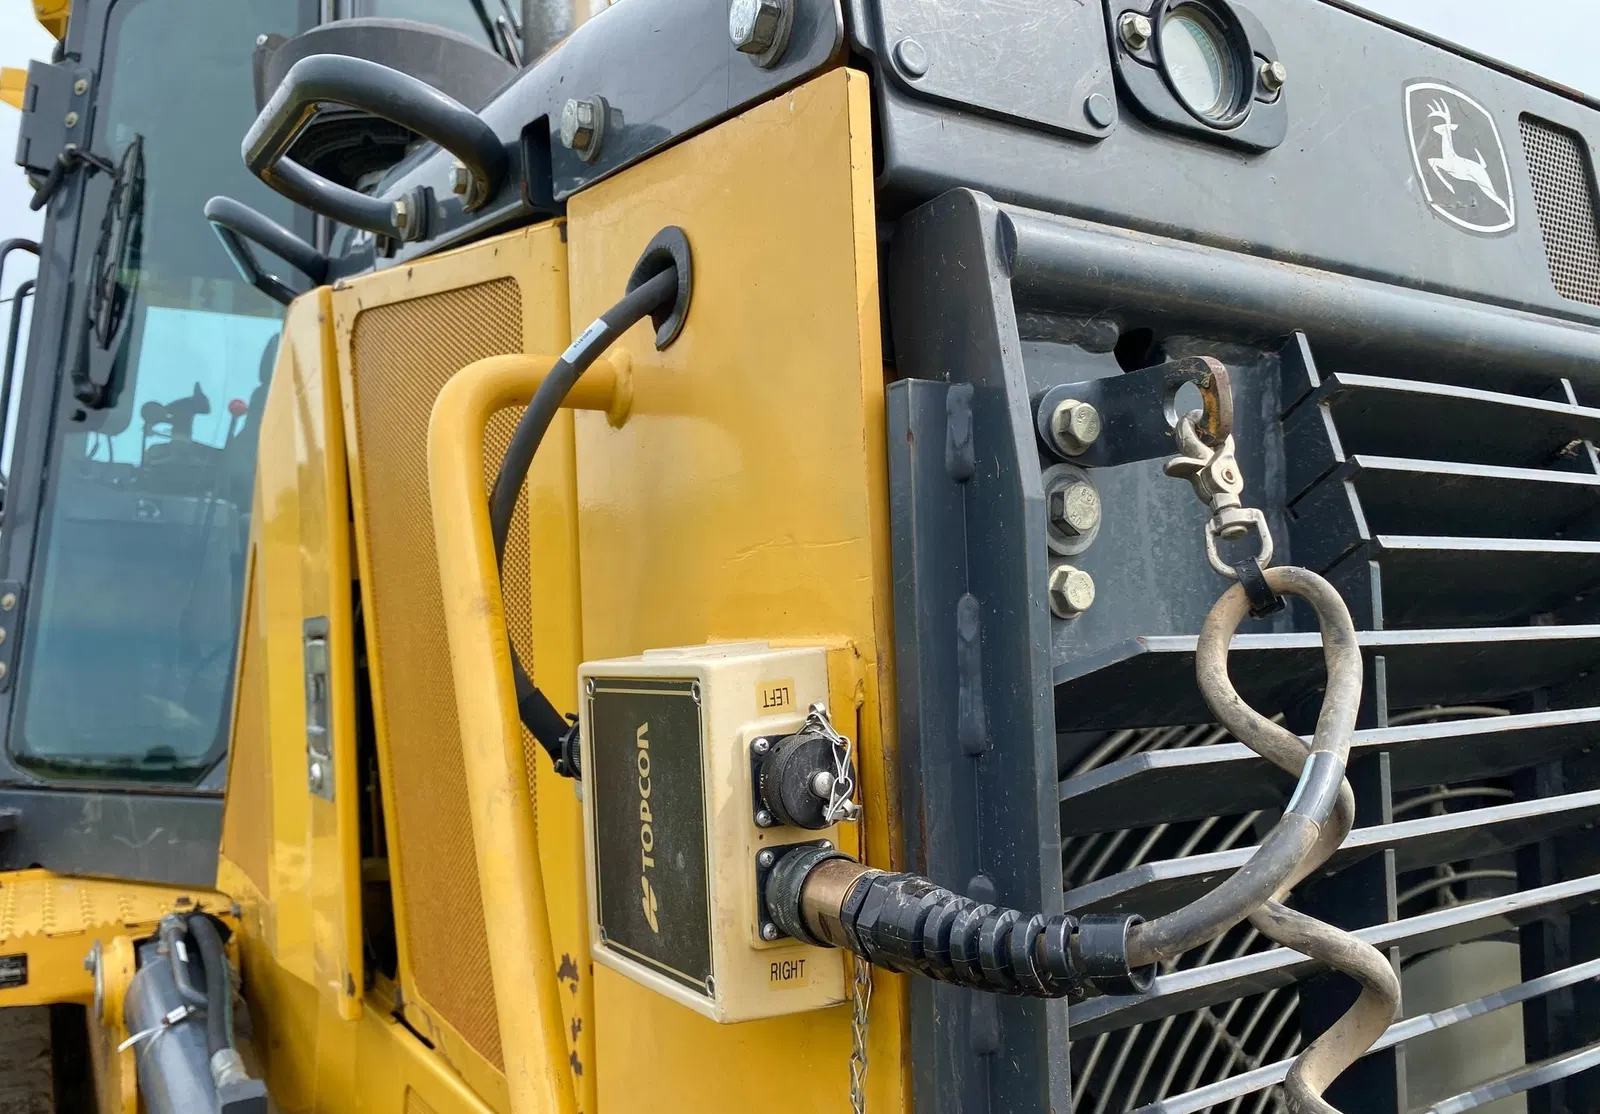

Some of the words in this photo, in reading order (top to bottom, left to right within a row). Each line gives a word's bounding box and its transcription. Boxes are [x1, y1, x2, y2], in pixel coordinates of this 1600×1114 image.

[763, 687, 790, 708] LEFT
[636, 721, 656, 873] TOPCON
[770, 959, 806, 981] RIGHT
